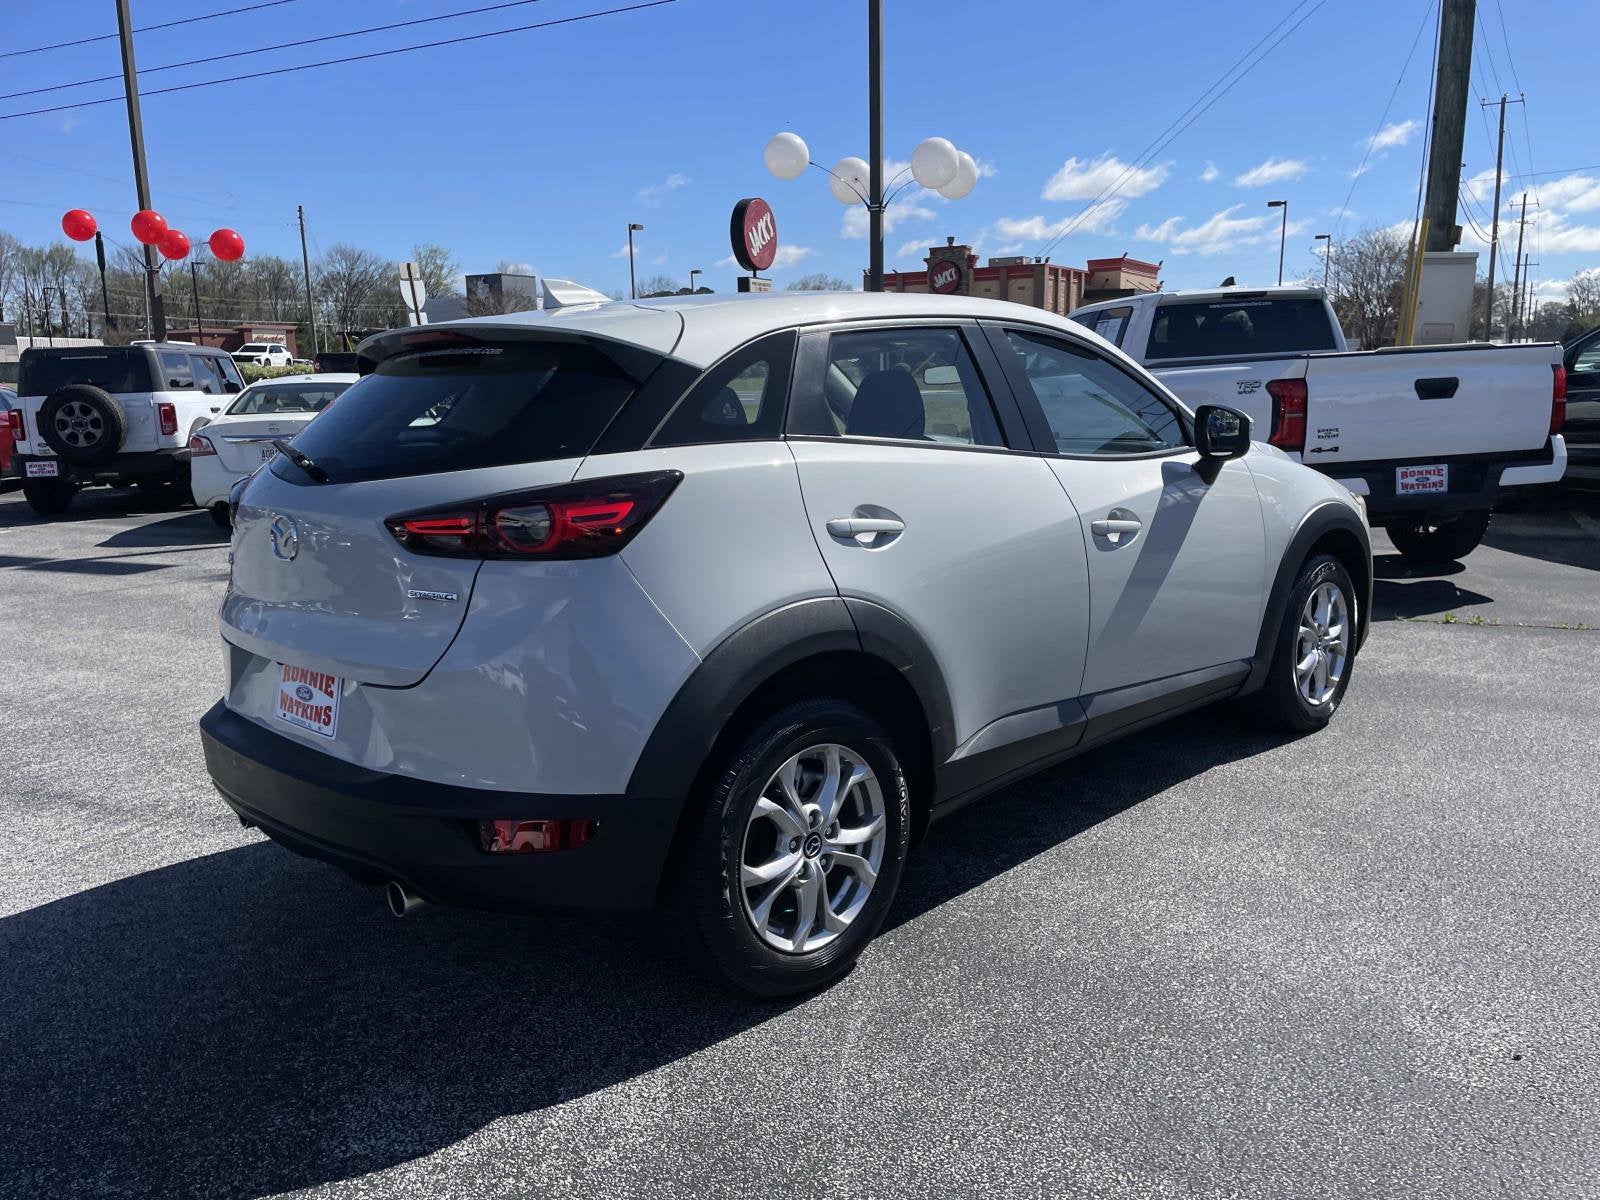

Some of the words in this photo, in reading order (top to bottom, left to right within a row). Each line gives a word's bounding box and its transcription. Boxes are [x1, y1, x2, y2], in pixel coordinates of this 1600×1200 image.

[1400, 468, 1444, 480] RONNIE
[1400, 479, 1444, 491] WATKINS
[282, 664, 336, 700] RONNIE
[279, 688, 333, 727] WATKINS
